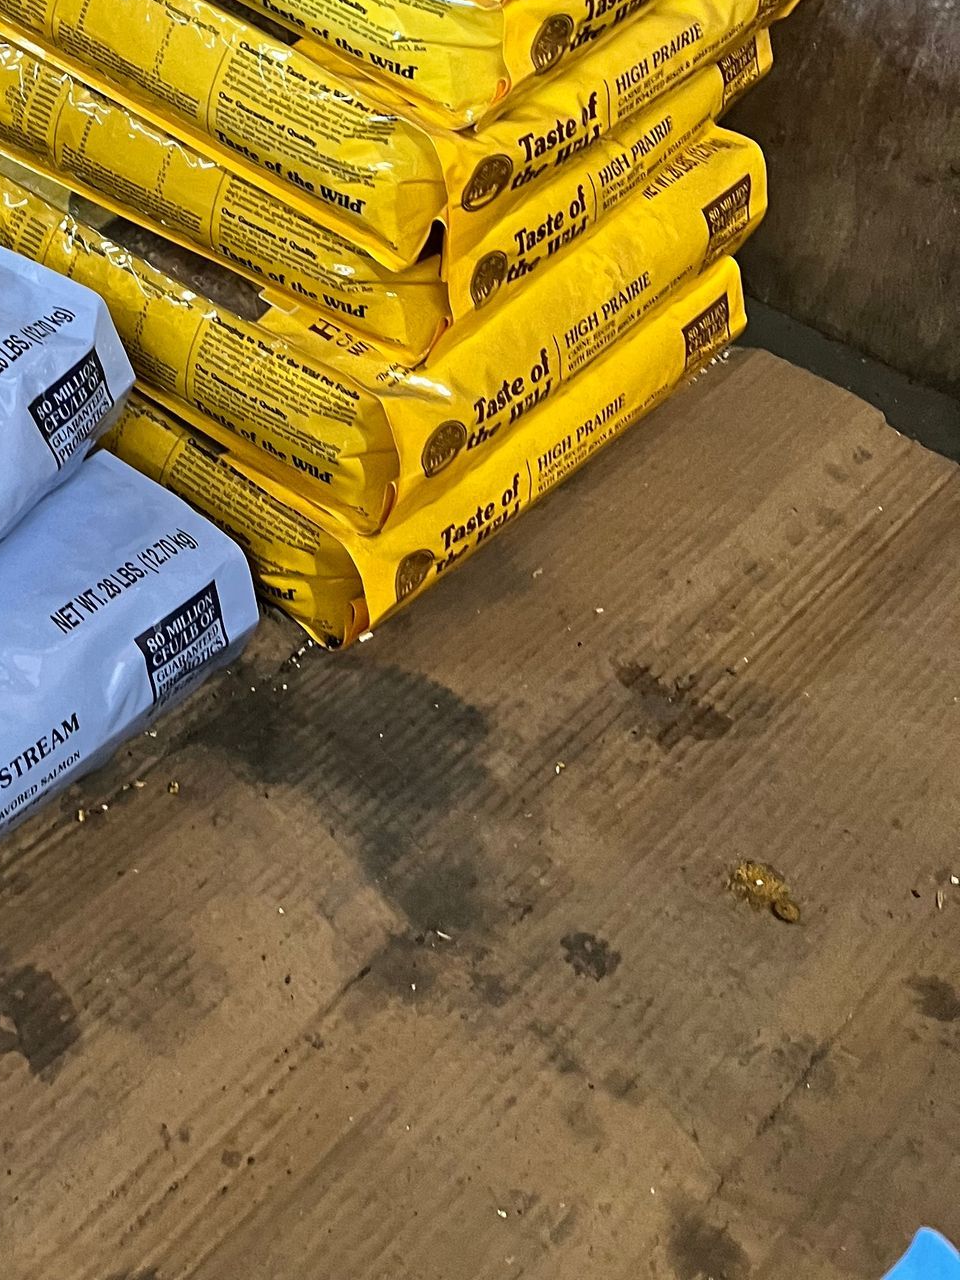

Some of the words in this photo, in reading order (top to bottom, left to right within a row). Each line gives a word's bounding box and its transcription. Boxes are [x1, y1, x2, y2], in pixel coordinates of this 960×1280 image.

[311, 26, 330, 40] of
[335, 36, 364, 58] the
[370, 52, 417, 79] Wild
[615, 59, 649, 95] HIGH
[652, 23, 703, 68] PRAIRIE
[519, 119, 577, 162] Taste
[581, 92, 598, 132] of
[598, 153, 631, 187] HIGH
[631, 115, 672, 162] PRAIRIE
[215, 129, 260, 162] Taste
[265, 160, 283, 174] of
[288, 169, 315, 191] the
[320, 185, 365, 214] Wild
[514, 214, 564, 257] Taste
[569, 184, 587, 223] of
[44, 306, 76, 323] kg)
[219, 244, 263, 274] Taste
[269, 274, 287, 286] of
[291, 281, 318, 301] the
[322, 293, 367, 319] Wild
[564, 312, 599, 348] HIGH
[601, 271, 652, 320] PRAIRIE
[36, 402, 53, 420] 80
[54, 361, 97, 403] MILLION
[43, 389, 88, 433] CFU/LB
[88, 372, 100, 391] OF
[52, 388, 105, 448] GUARANTEED
[474, 379, 525, 424] Taste
[531, 350, 549, 389] of
[240, 427, 257, 443] of
[262, 439, 286, 461] the
[292, 455, 333, 485] Wild
[537, 435, 572, 471] HIGH
[576, 393, 627, 442] PRAIRIE
[441, 503, 495, 552] Taste
[501, 473, 520, 511] of
[50, 602, 85, 635] NET
[74, 588, 108, 614] WT.
[97, 579, 122, 600] 28
[110, 561, 148, 589] LBS.
[137, 538, 178, 574] (12.70
[166, 527, 199, 550] kg)
[146, 633, 165, 654] 80
[166, 592, 214, 635] MILLION
[152, 624, 199, 667] CFU/LB
[202, 608, 215, 628] OF
[156, 623, 219, 683] GUARANTEED
[40, 750, 82, 787] SALMON
